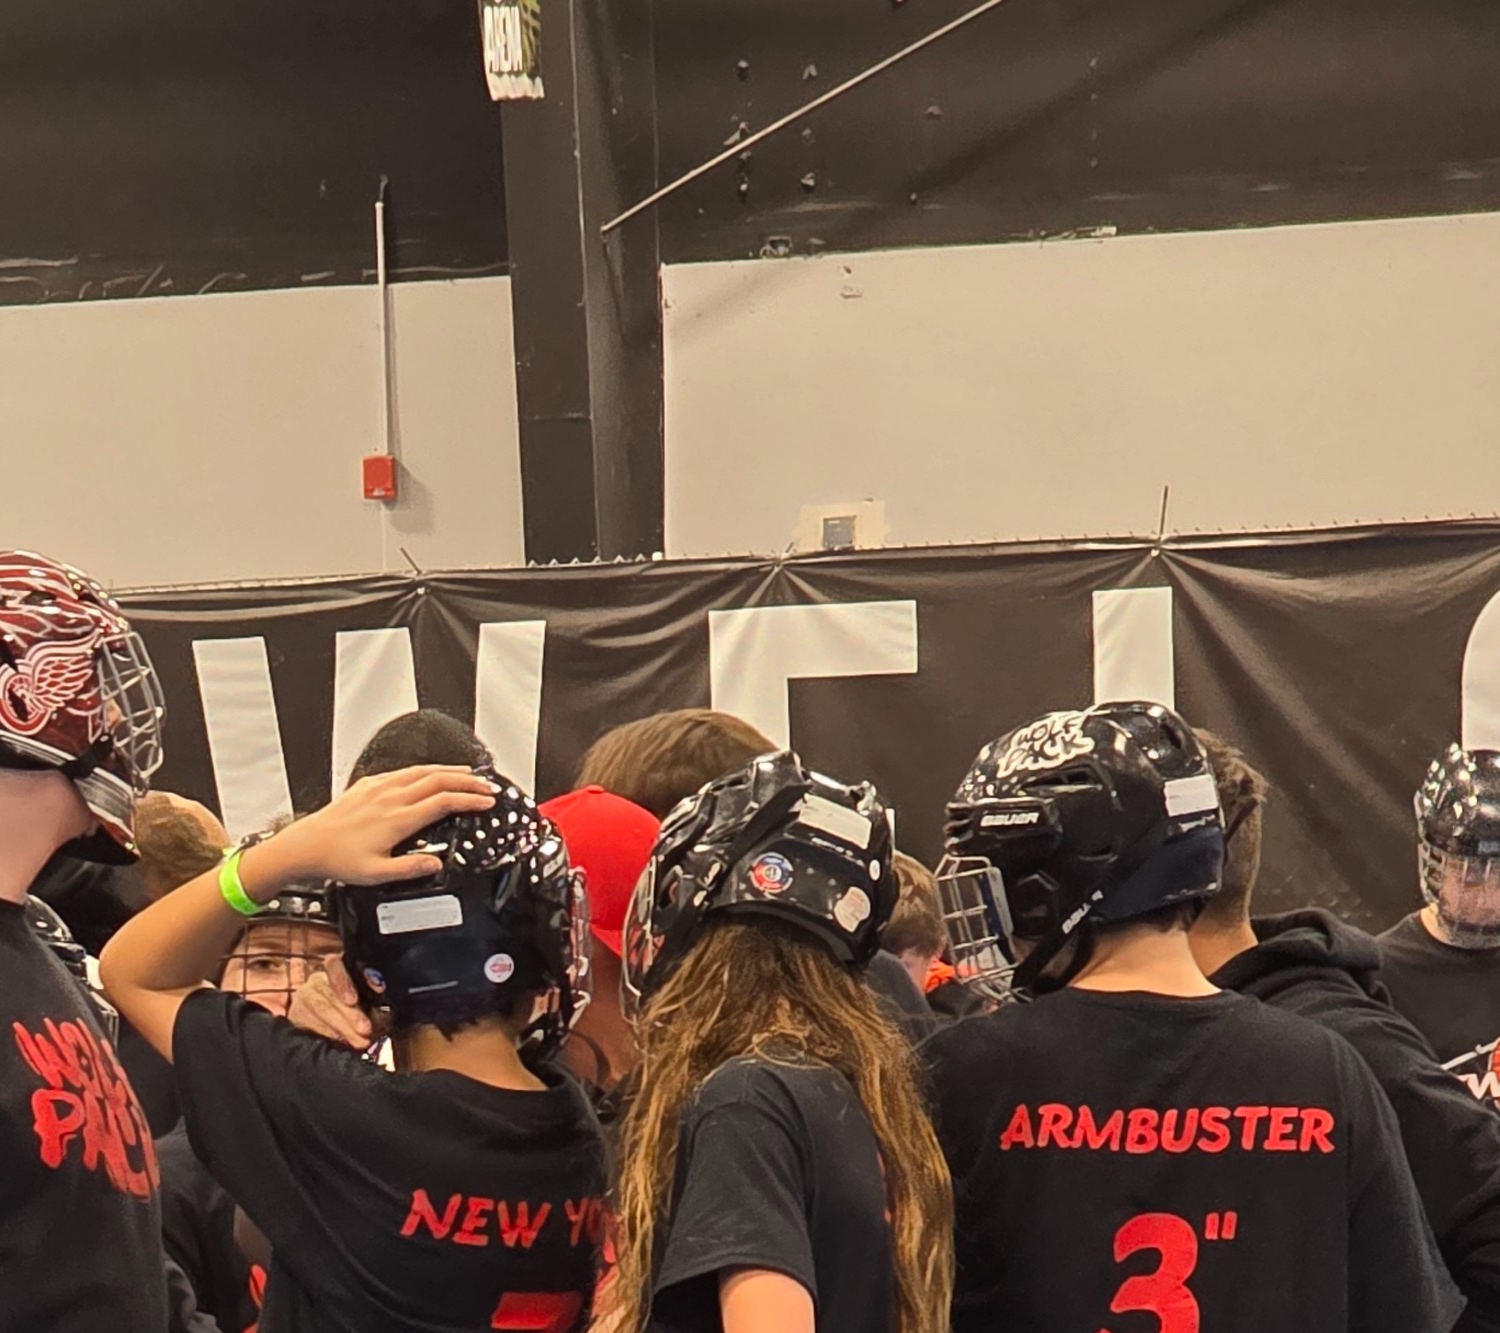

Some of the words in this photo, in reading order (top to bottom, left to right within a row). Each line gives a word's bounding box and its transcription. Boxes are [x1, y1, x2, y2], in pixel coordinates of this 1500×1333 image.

[980, 812, 1040, 827] BAUER
[999, 1103, 1336, 1154] ARMBUSTER
[400, 1188, 552, 1249] NEW
